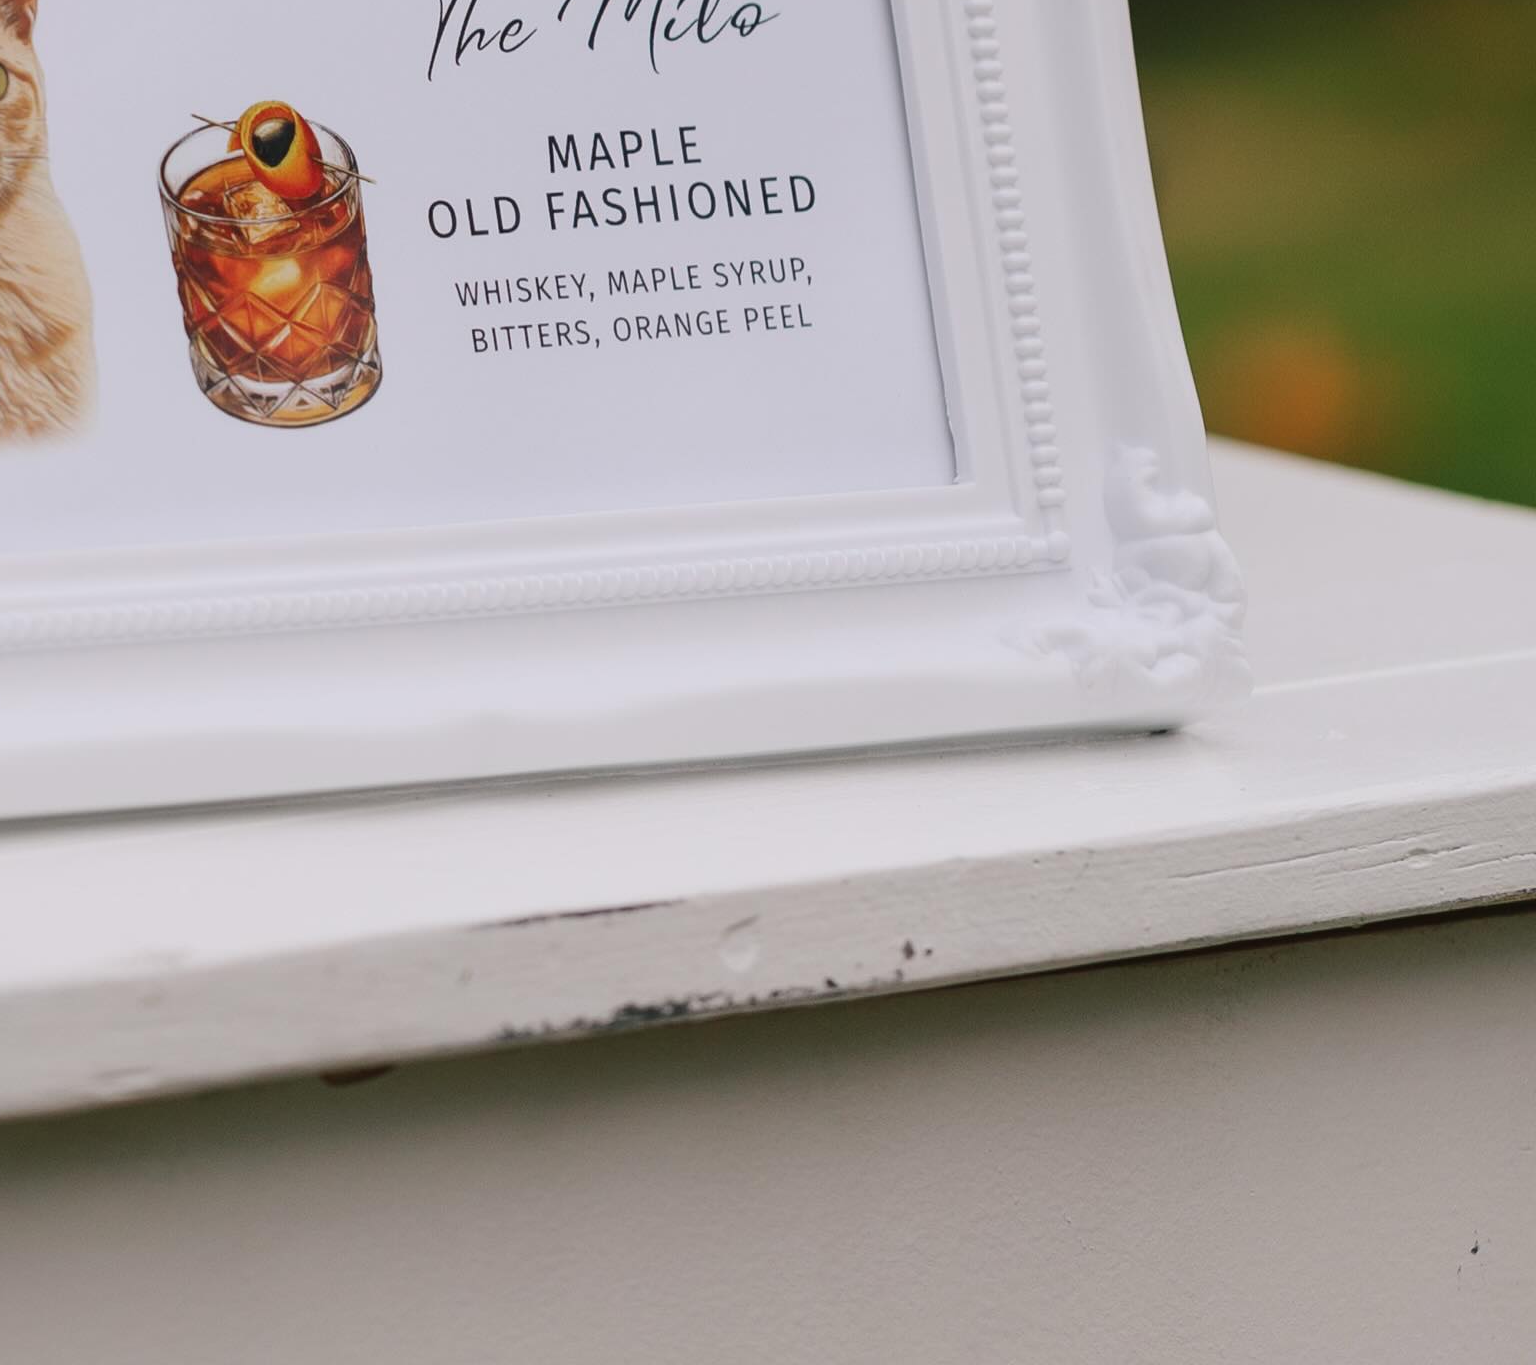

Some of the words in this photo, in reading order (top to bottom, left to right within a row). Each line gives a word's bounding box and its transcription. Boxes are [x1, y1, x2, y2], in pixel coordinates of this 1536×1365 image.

[548, 125, 702, 173] MAPLE
[428, 196, 520, 239] OLD
[546, 175, 815, 230] FASHIONED
[454, 273, 594, 307] WHISKEY,
[608, 265, 702, 296] MAPLE
[713, 257, 812, 288] SYRUP,
[472, 320, 600, 353] BITTERS,
[613, 309, 731, 342] ORANGE
[744, 303, 812, 332] PEEL
